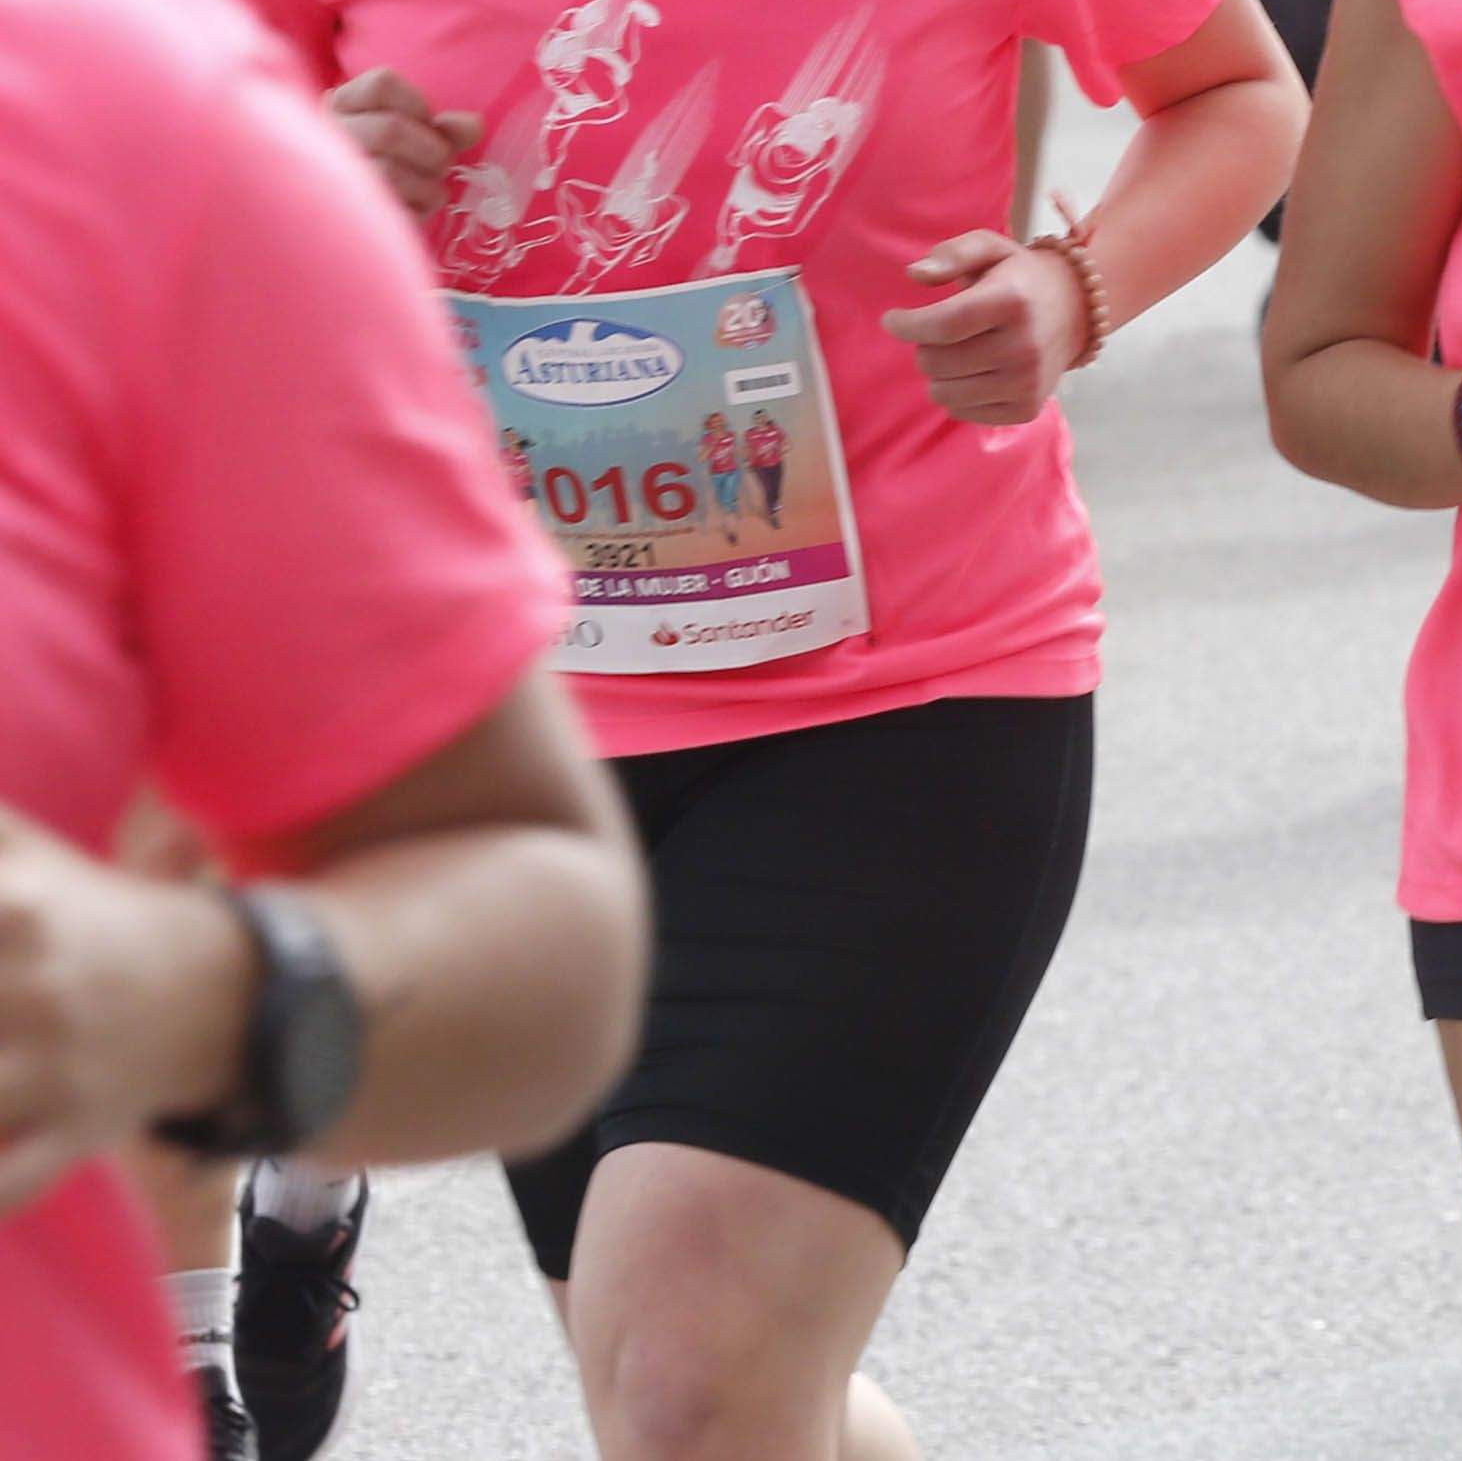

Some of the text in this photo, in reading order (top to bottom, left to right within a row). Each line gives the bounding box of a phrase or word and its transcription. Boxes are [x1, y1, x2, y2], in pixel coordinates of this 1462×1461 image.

[511, 345, 673, 385] ASTURIANA
[543, 461, 698, 525] 016
[584, 541, 656, 569] 3921
[681, 609, 816, 646] Santander
